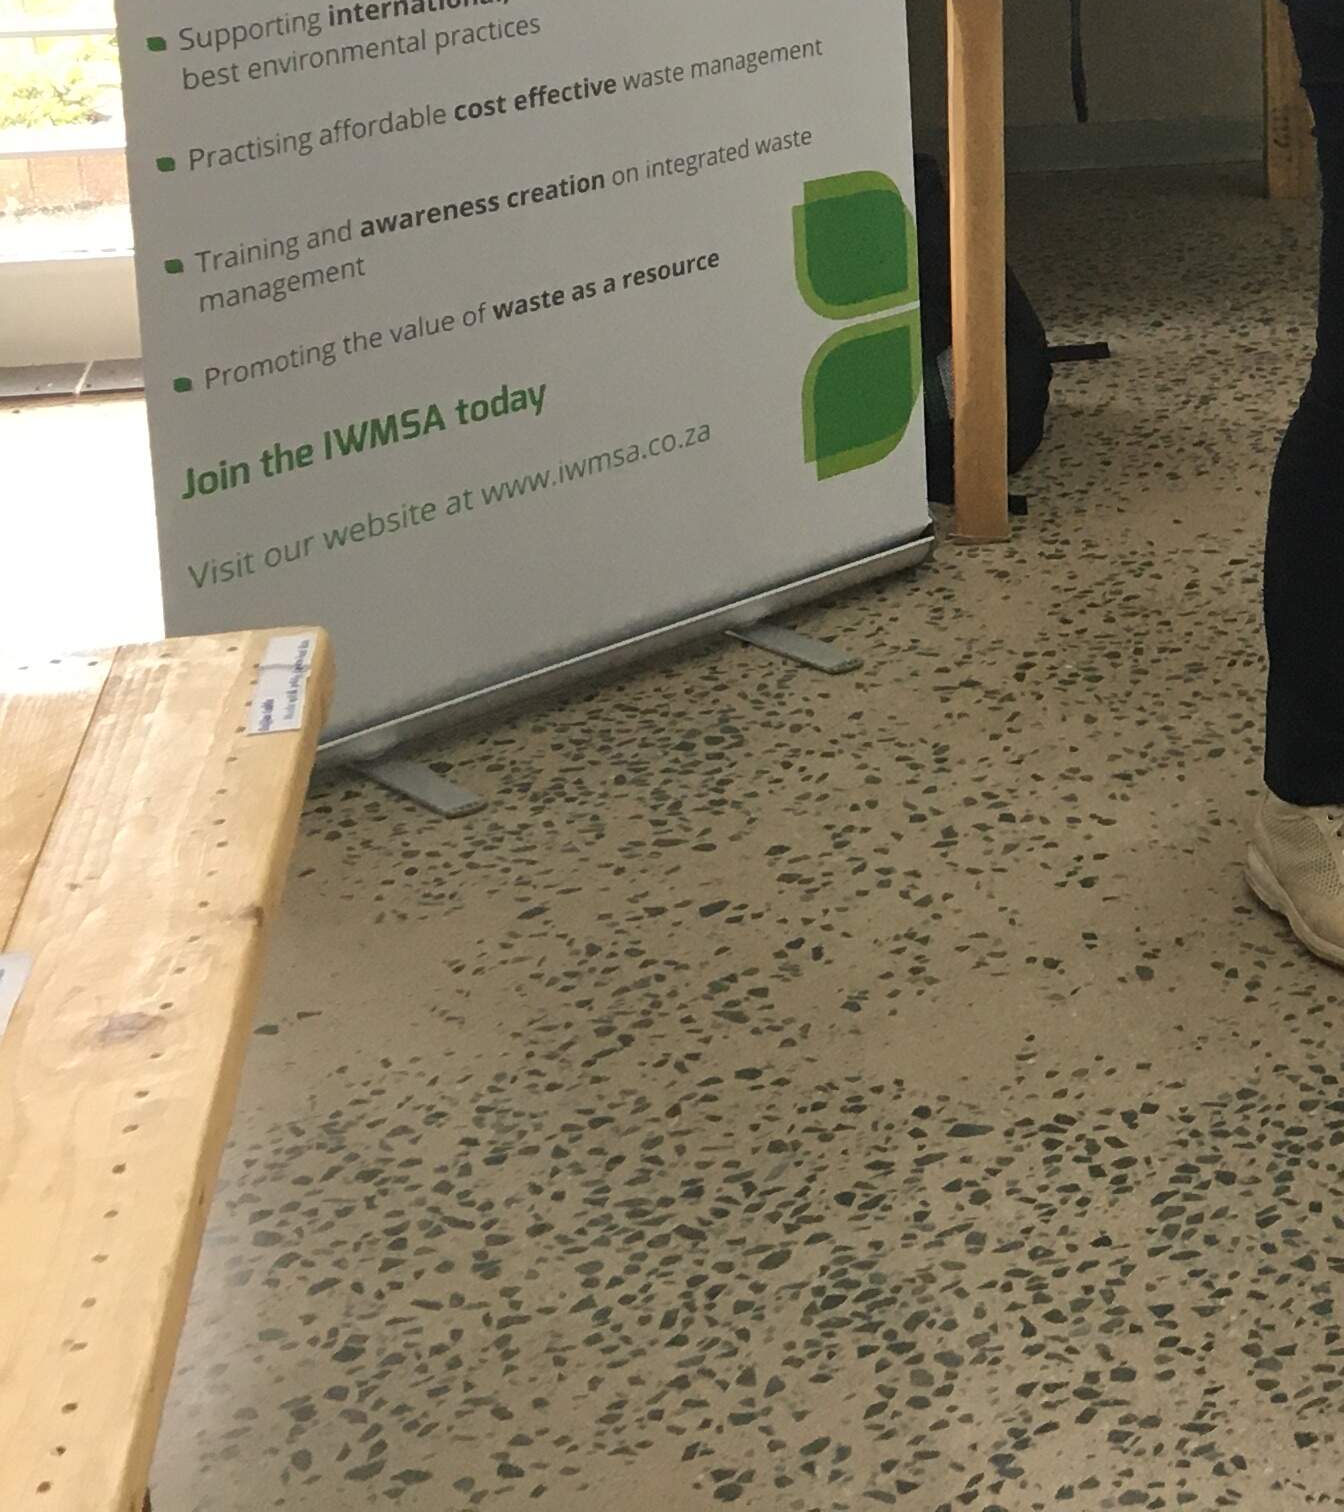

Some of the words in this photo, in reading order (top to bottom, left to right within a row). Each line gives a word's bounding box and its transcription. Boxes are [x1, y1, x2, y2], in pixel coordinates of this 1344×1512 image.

[189, 131, 313, 171] Practising
[319, 105, 447, 146] affordable
[454, 95, 507, 122] cost
[514, 77, 617, 111] effective
[623, 66, 684, 91] waste
[691, 40, 823, 79] management
[182, 460, 250, 499] Join
[260, 443, 314, 477] the
[324, 404, 446, 460] IWMSA
[455, 384, 546, 425] today
[188, 553, 255, 589] Visit
[264, 535, 314, 568] our
[322, 502, 436, 550] website
[446, 489, 474, 516] at
[481, 424, 710, 505] www.iwmsa.co.za
